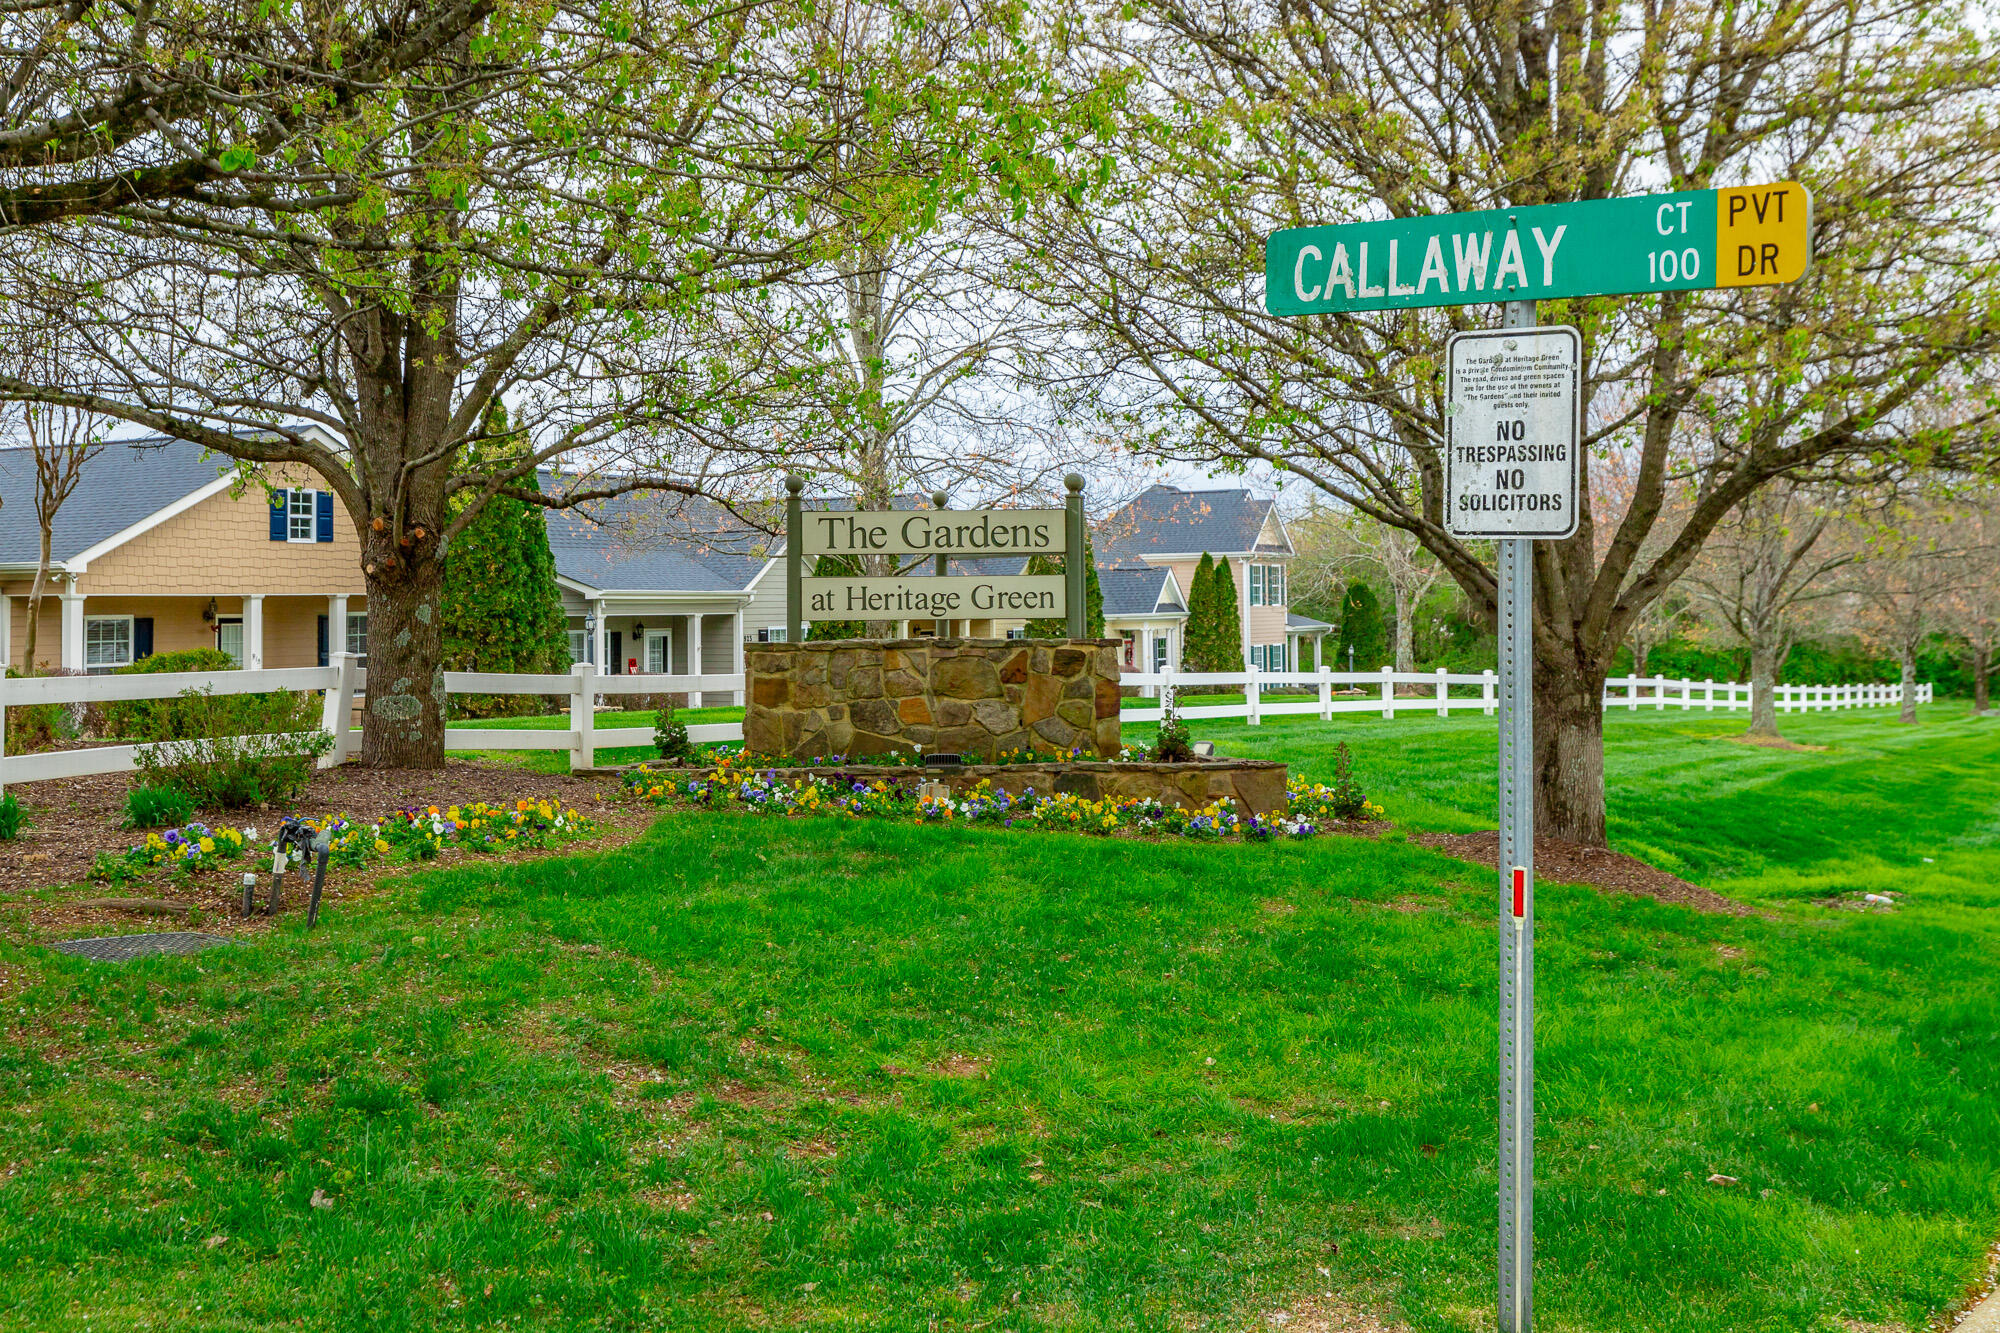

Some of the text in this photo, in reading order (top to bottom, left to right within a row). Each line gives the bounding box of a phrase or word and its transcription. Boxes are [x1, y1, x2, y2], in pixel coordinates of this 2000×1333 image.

[1656, 201, 1692, 236] CT
[1729, 190, 1789, 227] PVT
[1294, 225, 1567, 302] CALLAWAY
[1648, 248, 1700, 283] 100
[1738, 243, 1779, 277] DR
[1496, 420, 1525, 441] NO
[1456, 444, 1566, 463] TRESPASSING
[1496, 469, 1524, 490] NO
[1459, 493, 1562, 511] SOLICITORS
[818, 515, 1050, 549] The Gardens
[811, 584, 1055, 617] at Heritage Green
